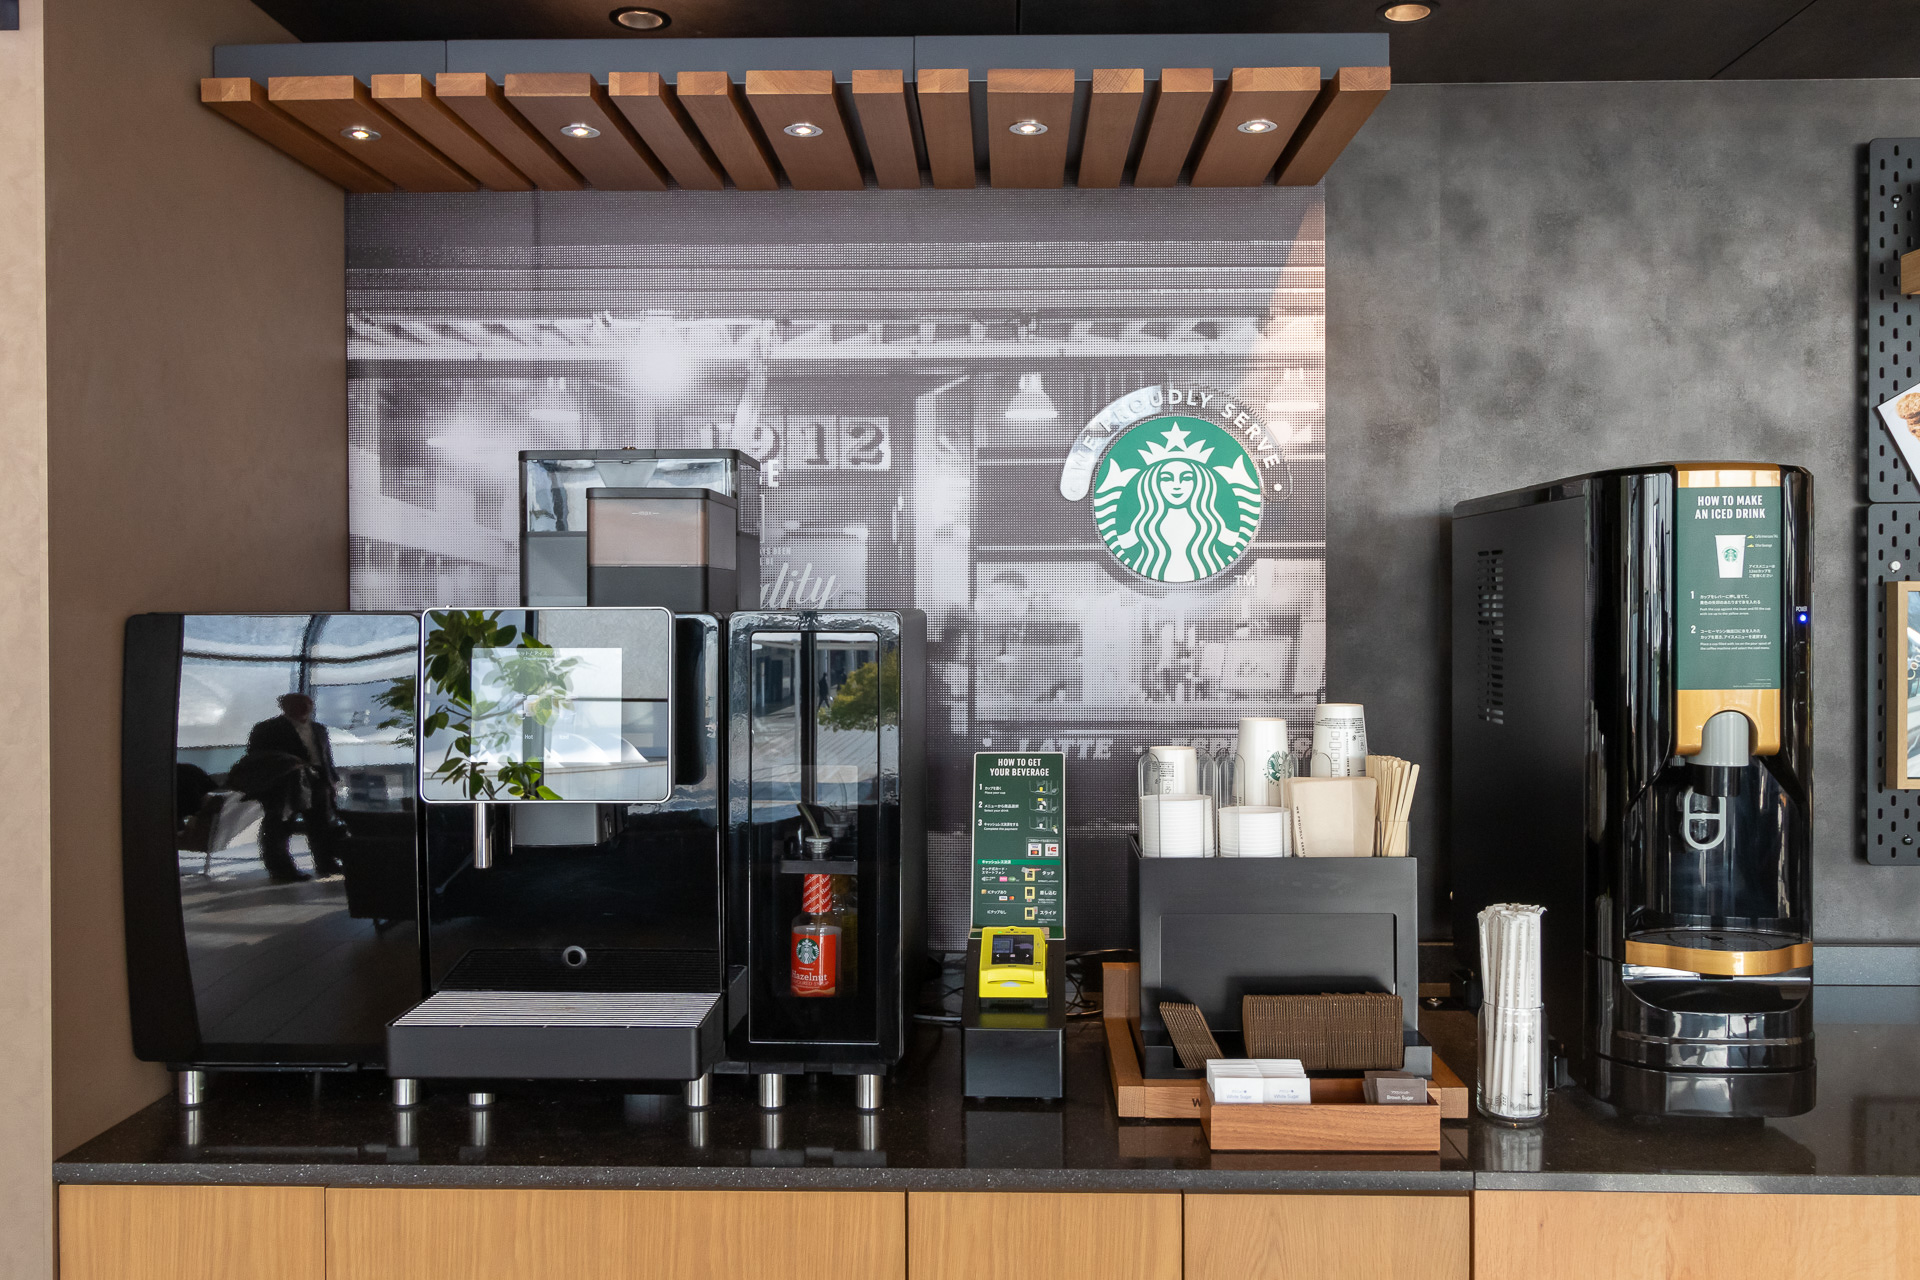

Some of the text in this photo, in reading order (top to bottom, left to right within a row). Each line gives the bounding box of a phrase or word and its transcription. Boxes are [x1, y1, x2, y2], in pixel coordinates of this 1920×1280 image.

[1071, 389, 1281, 471] WE PROUDLY SERVE
[1697, 495, 1763, 506] HOW TO MAKE
[1694, 508, 1766, 519] AN ICED DRINK
[1690, 591, 1694, 599] 1
[1690, 625, 1696, 634] 2
[792, 969, 827, 981] Hazelnut
